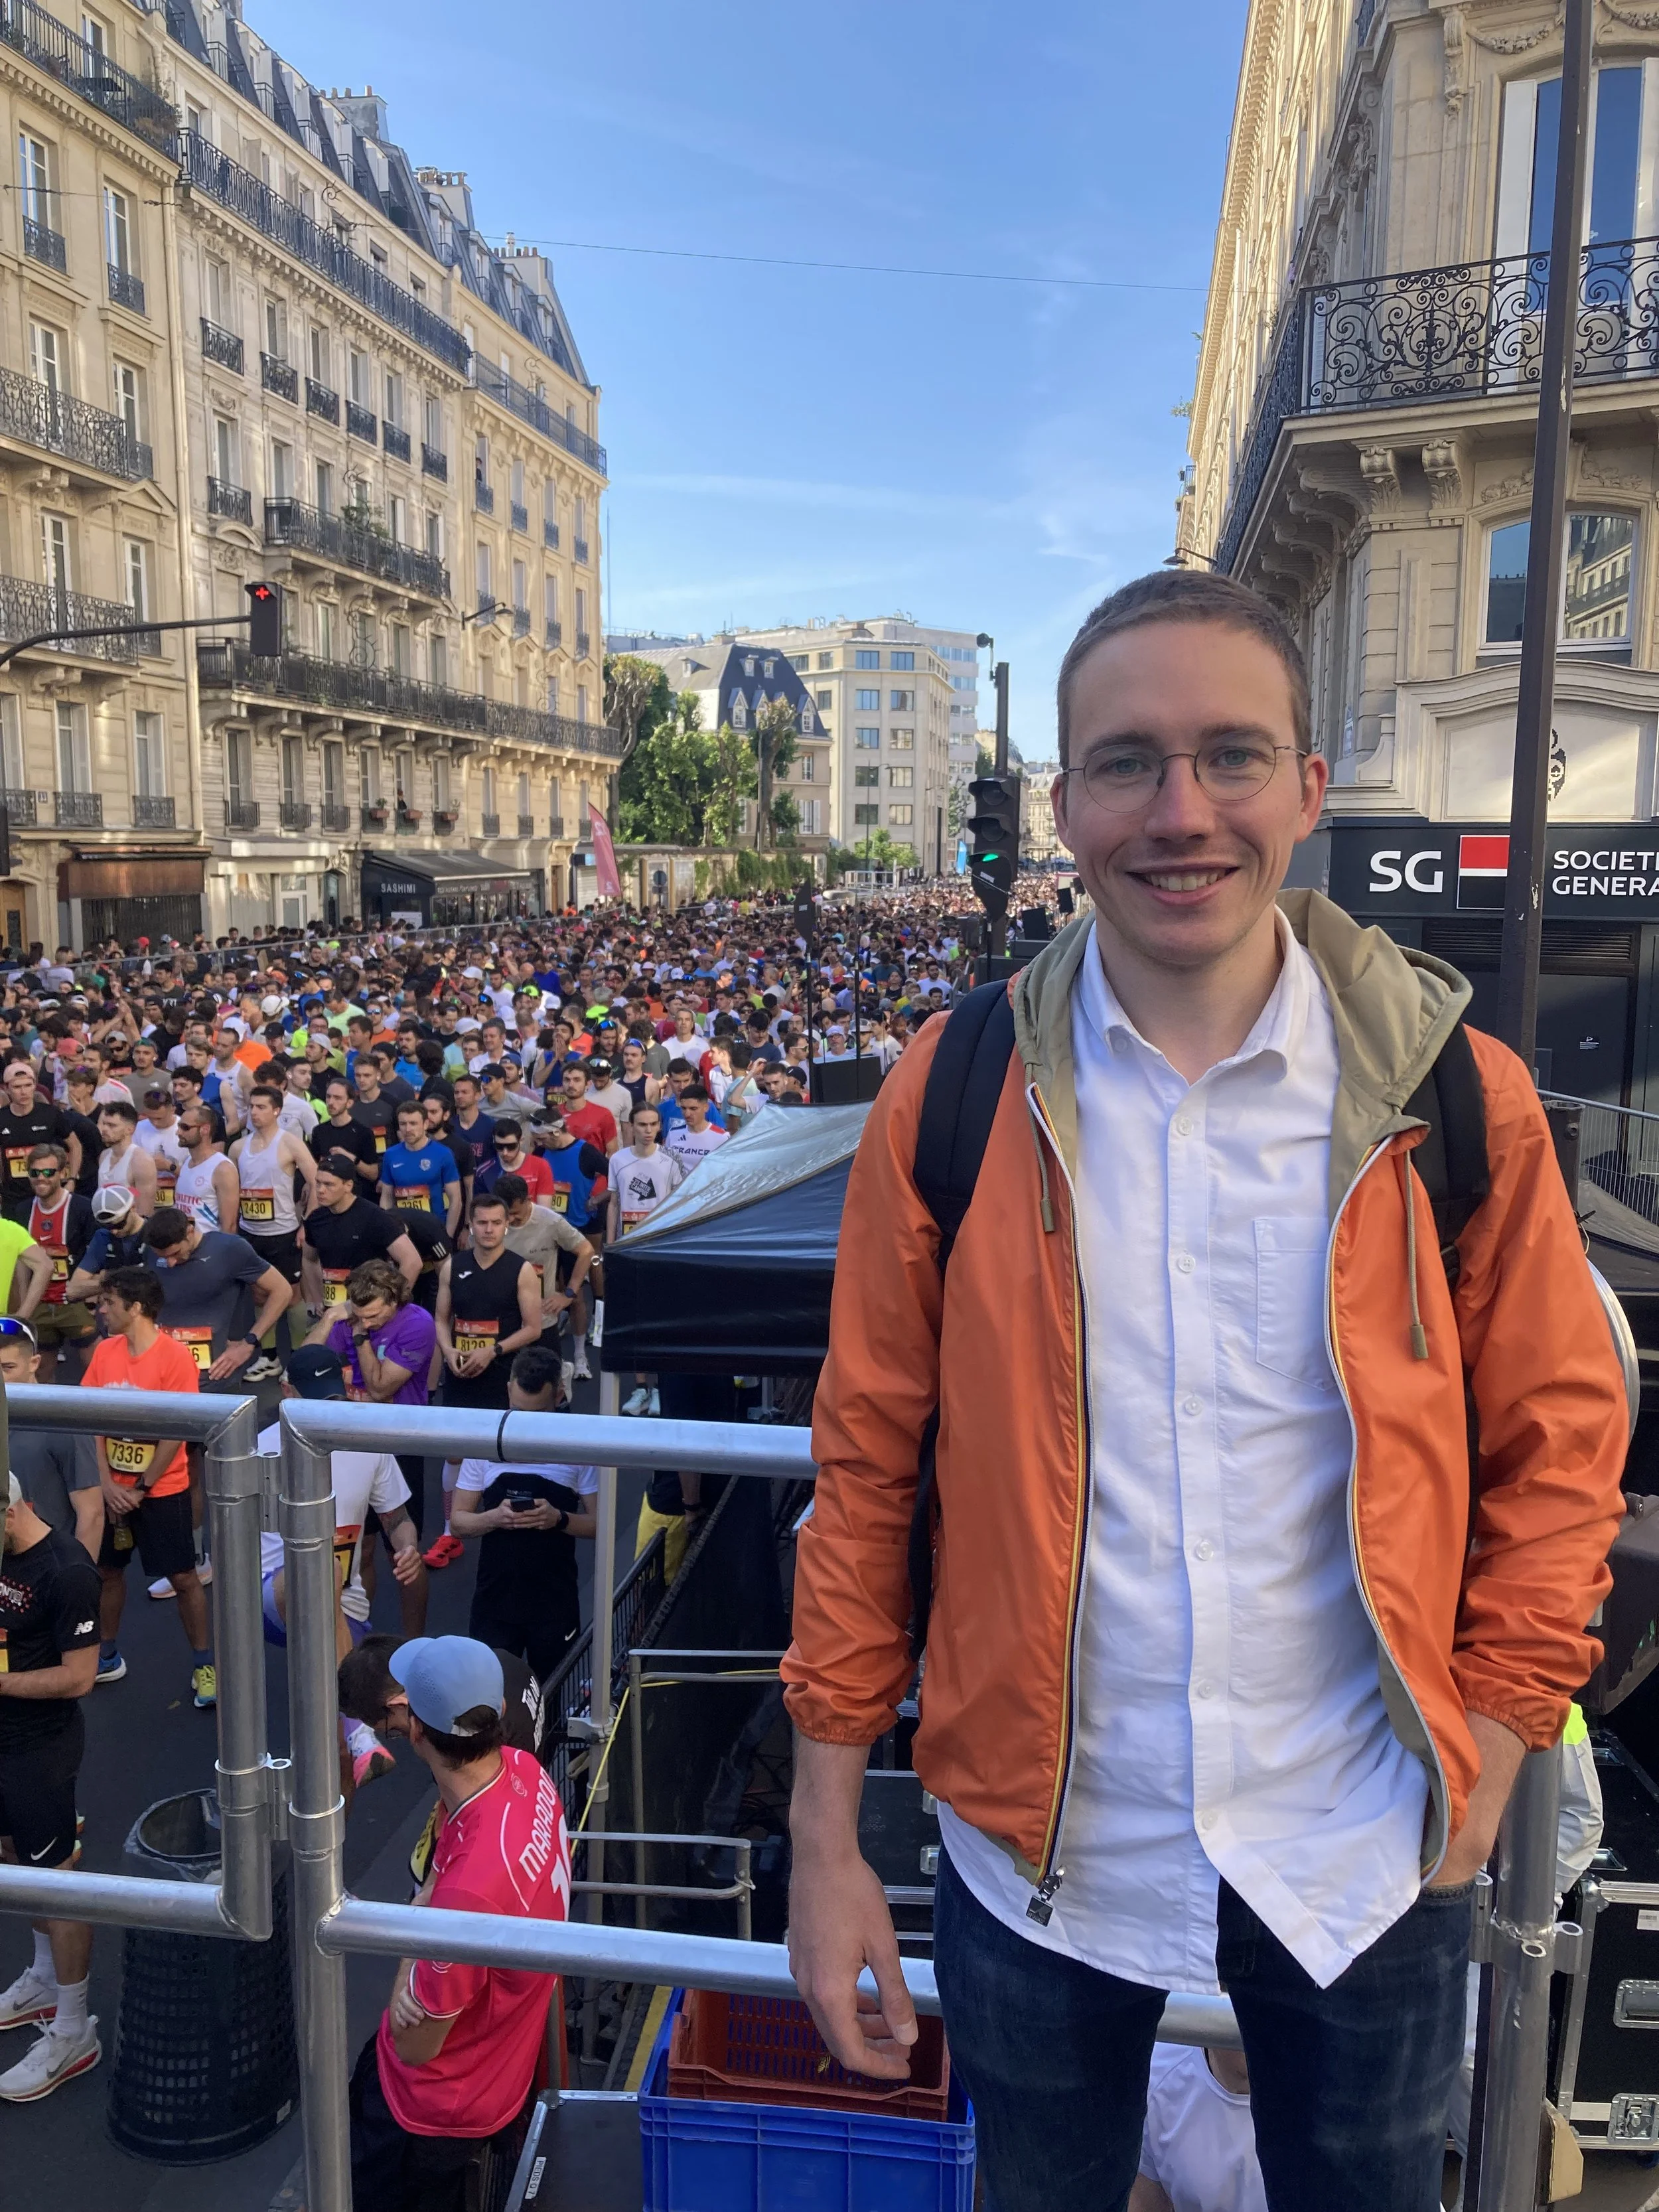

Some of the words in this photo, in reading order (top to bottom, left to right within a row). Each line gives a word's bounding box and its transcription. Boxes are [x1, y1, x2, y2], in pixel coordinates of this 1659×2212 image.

[1369, 850, 1444, 893] SG
[381, 883, 416, 894] SASHIMI
[1551, 875, 1659, 896] GENERA
[245, 1203, 265, 1214] 2430
[112, 1442, 144, 1464] 7336
[532, 2160, 543, 2181] PIEDS
